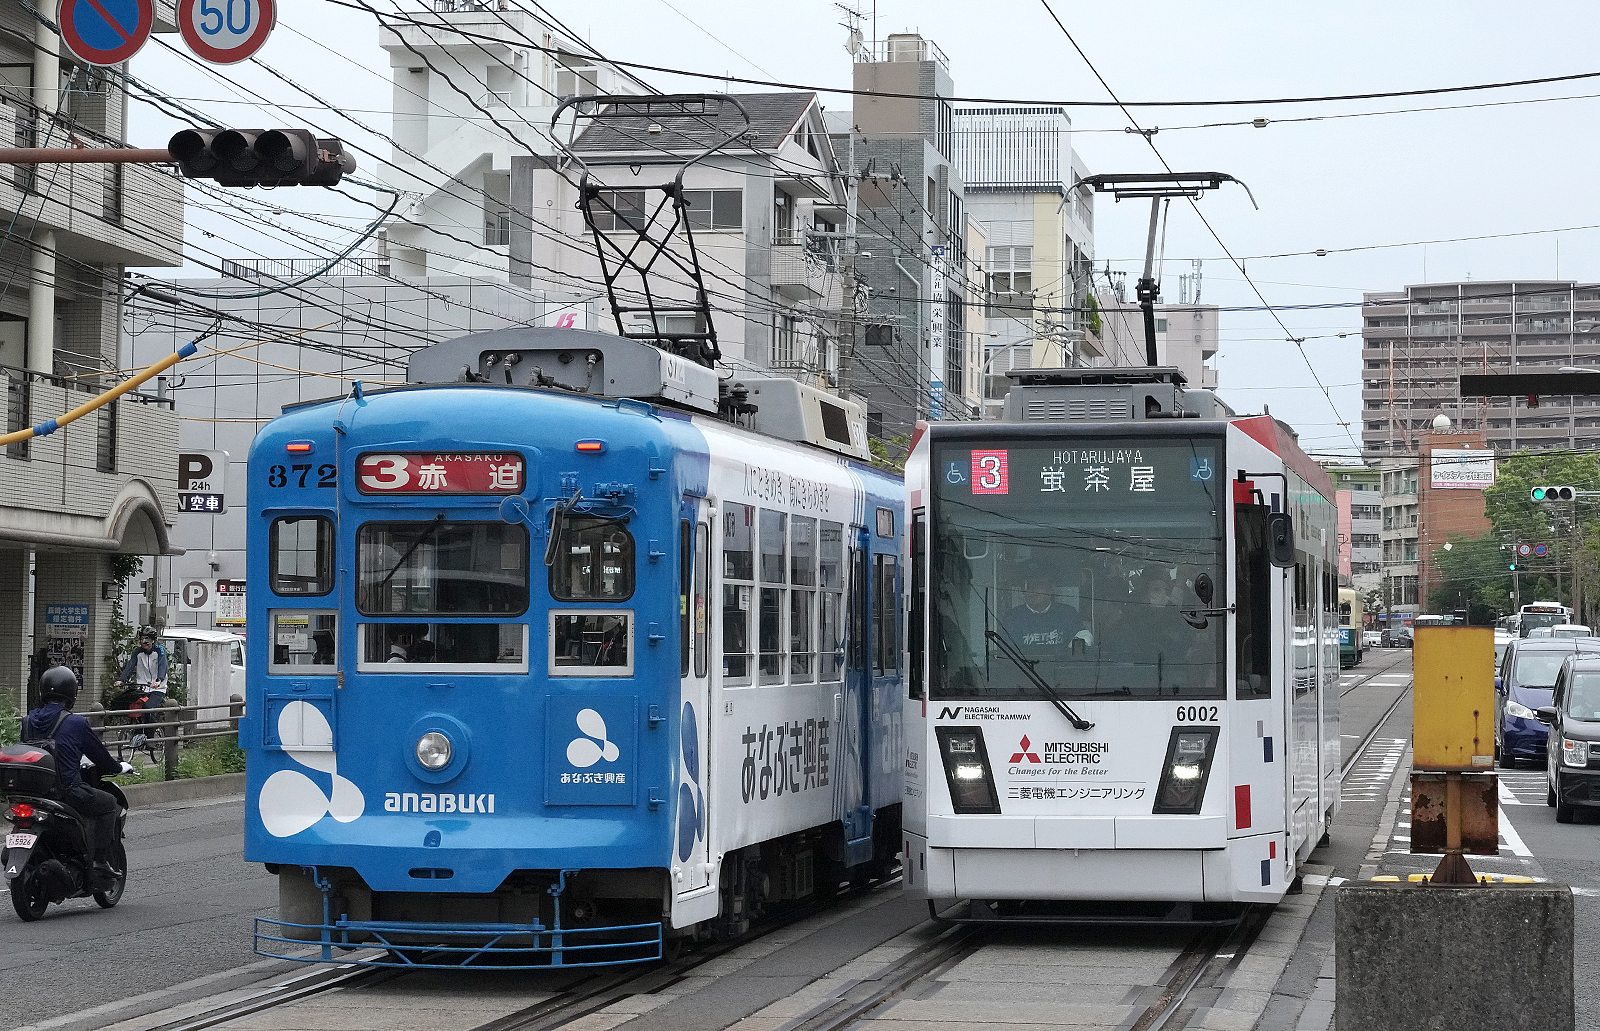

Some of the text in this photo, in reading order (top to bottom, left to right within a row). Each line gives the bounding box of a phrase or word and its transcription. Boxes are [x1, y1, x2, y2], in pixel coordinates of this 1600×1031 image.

[200, 0, 251, 35] 50
[1053, 450, 1143, 464] HOTARUJAYA
[178, 454, 213, 490] P
[268, 464, 337, 488] 372
[361, 455, 410, 490] 3
[979, 455, 1002, 490] 3
[191, 481, 211, 491] 24h
[190, 495, 220, 511] 空車
[188, 585, 204, 605] P
[1176, 706, 1219, 722] 6002
[1044, 742, 1109, 753] MITSUBISHI
[741, 717, 829, 804] あなぶき興産
[1044, 753, 1101, 764] ELECTRIC
[560, 772, 626, 784] あなぶき興産
[1008, 766, 1109, 776] Changes for the Better
[1007, 786, 1146, 800] 三菱電機エンジニアリング
